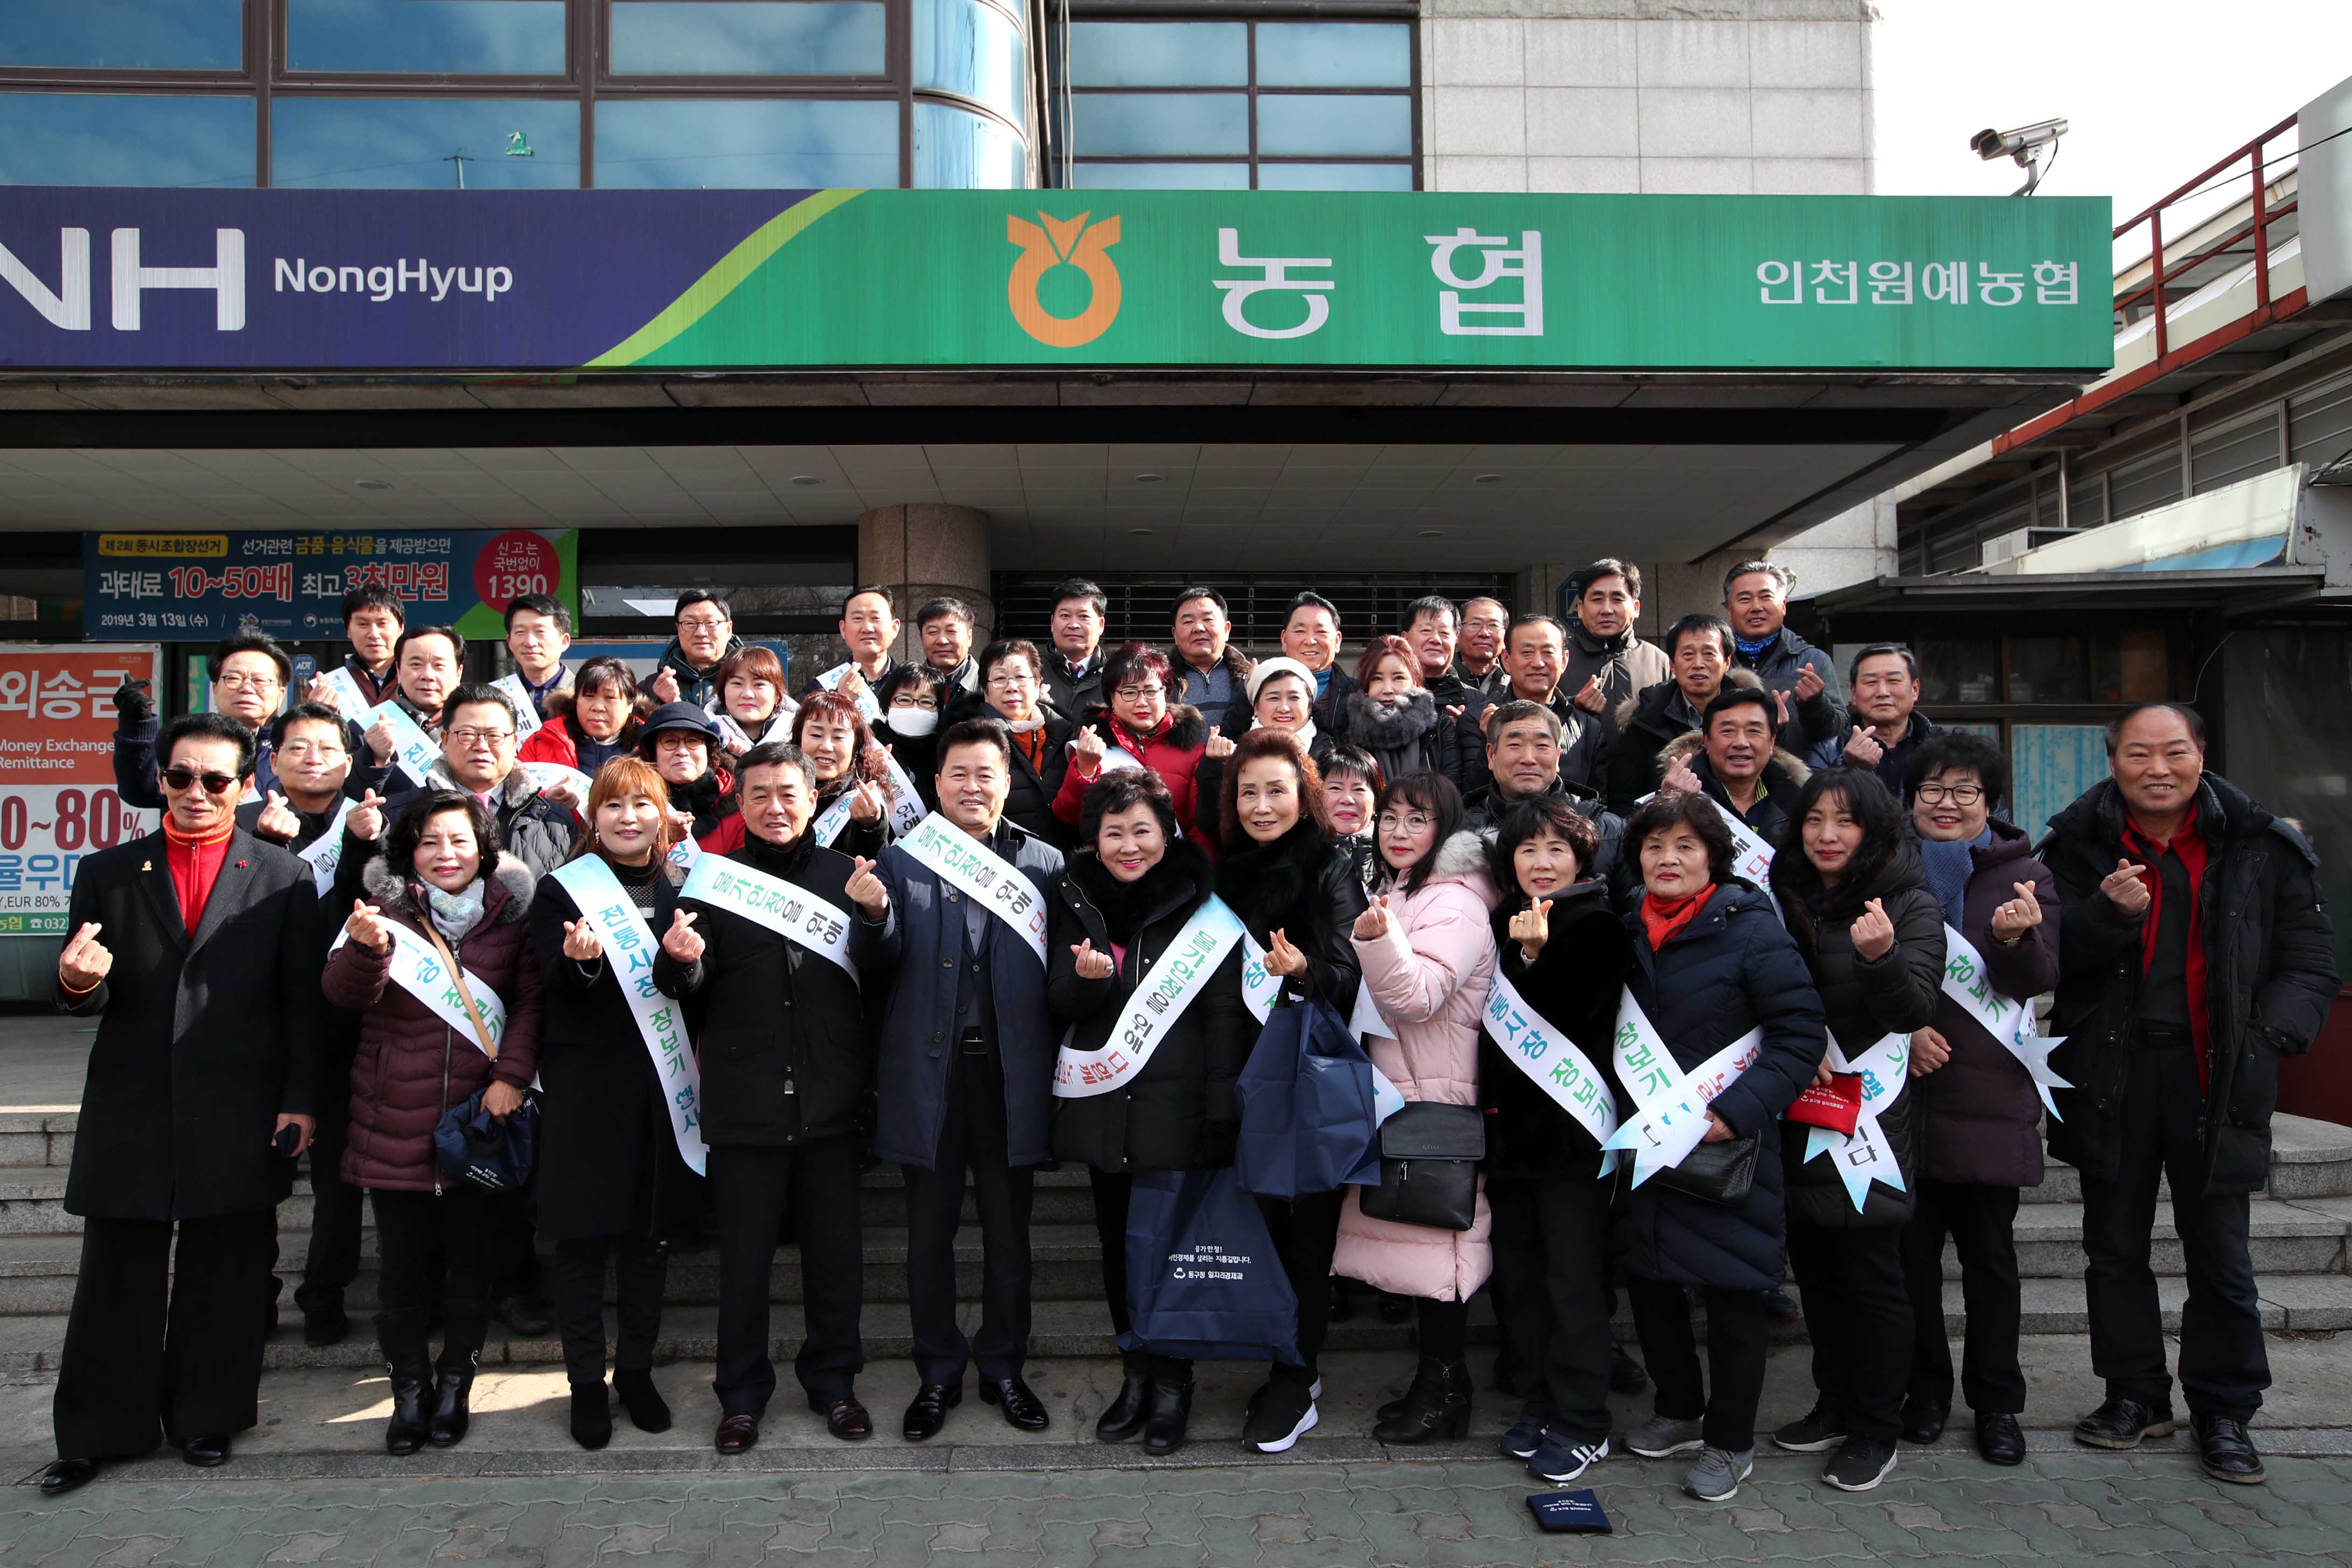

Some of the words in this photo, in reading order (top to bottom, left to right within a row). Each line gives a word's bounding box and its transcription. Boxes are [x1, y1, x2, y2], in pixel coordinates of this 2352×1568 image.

[275, 258, 513, 302] NongHyup
[1756, 260, 2078, 306] 인천원예농협
[242, 538, 292, 555] 선거관련
[389, 537, 451, 555] 제공받으면
[494, 557, 540, 572] 국번없이
[99, 570, 163, 599] 과태료
[168, 563, 292, 602] 10~50배
[302, 572, 342, 599] 최고
[488, 574, 548, 599] 1390
[101, 614, 134, 627] 2019년
[138, 613, 157, 627] 3월
[161, 613, 186, 628] 13일
[190, 615, 208, 628] (수)
[296, 661, 312, 670] ADT
[46, 739, 115, 754] Exchange
[35, 896, 60, 908] 80%
[1946, 954, 2009, 1023] 장보기
[649, 1006, 686, 1079] 장보기
[1615, 1021, 1672, 1096] 장보기
[1549, 1057, 1612, 1127] 장보기
[1188, 1271, 1205, 1279] 동구청
